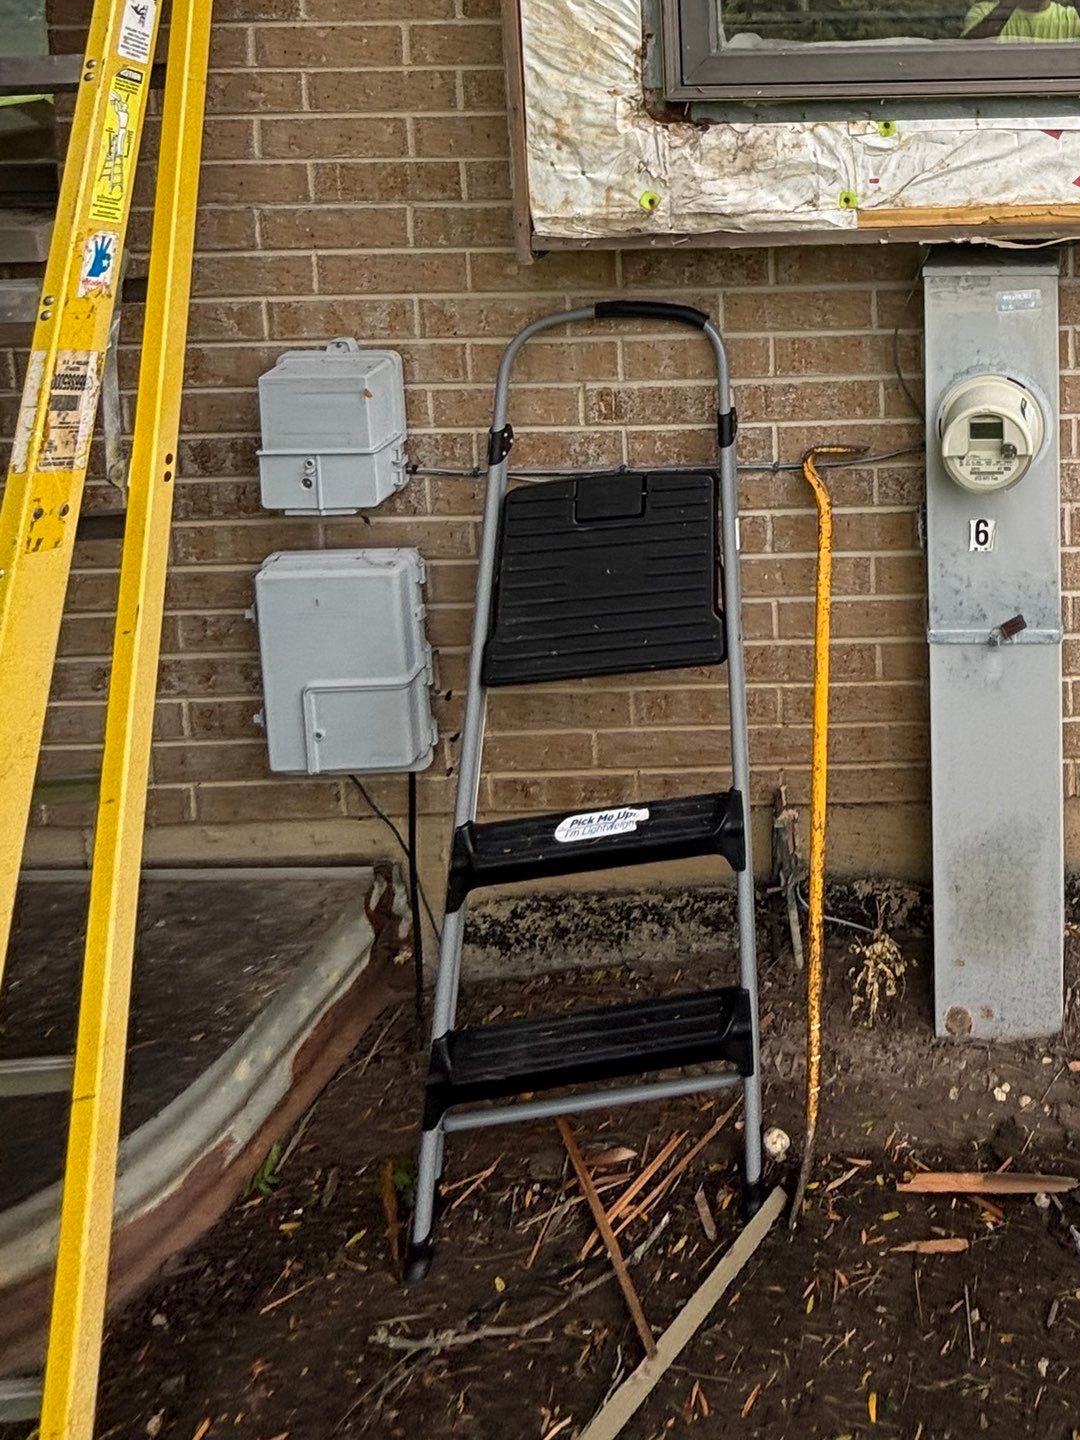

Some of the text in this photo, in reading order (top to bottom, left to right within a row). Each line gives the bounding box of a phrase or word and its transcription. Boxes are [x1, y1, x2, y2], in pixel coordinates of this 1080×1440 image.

[975, 519, 990, 546] 6
[569, 816, 595, 828] Pick
[597, 813, 614, 823] Me
